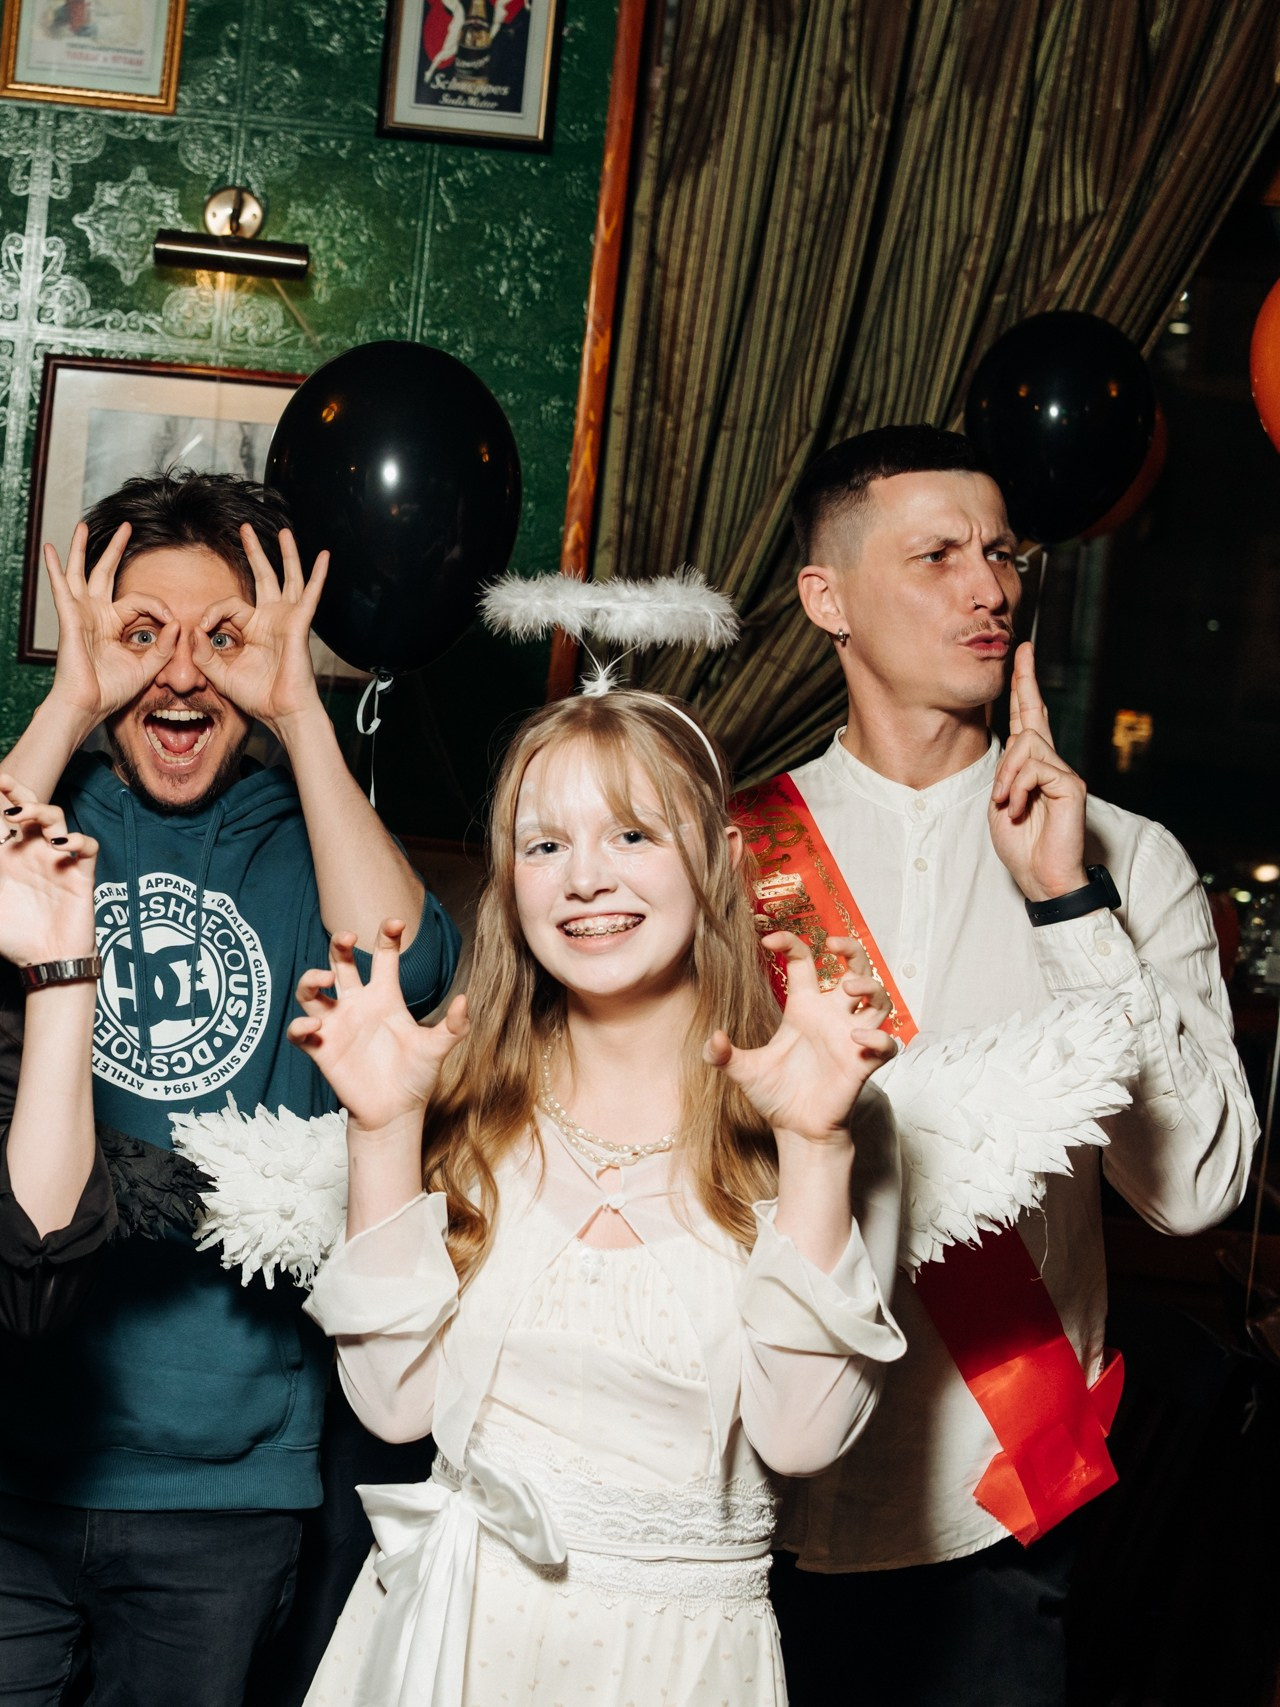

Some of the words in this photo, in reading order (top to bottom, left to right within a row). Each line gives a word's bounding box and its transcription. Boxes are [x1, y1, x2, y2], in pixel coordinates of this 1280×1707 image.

[94, 887, 114, 906] EAR
[217, 898, 259, 952] QUALITY
[240, 958, 267, 1053] GUARANTEED
[92, 1053, 144, 1090] ATHLET
[202, 1055, 241, 1087] SINCE
[163, 1081, 198, 1096] 1994
